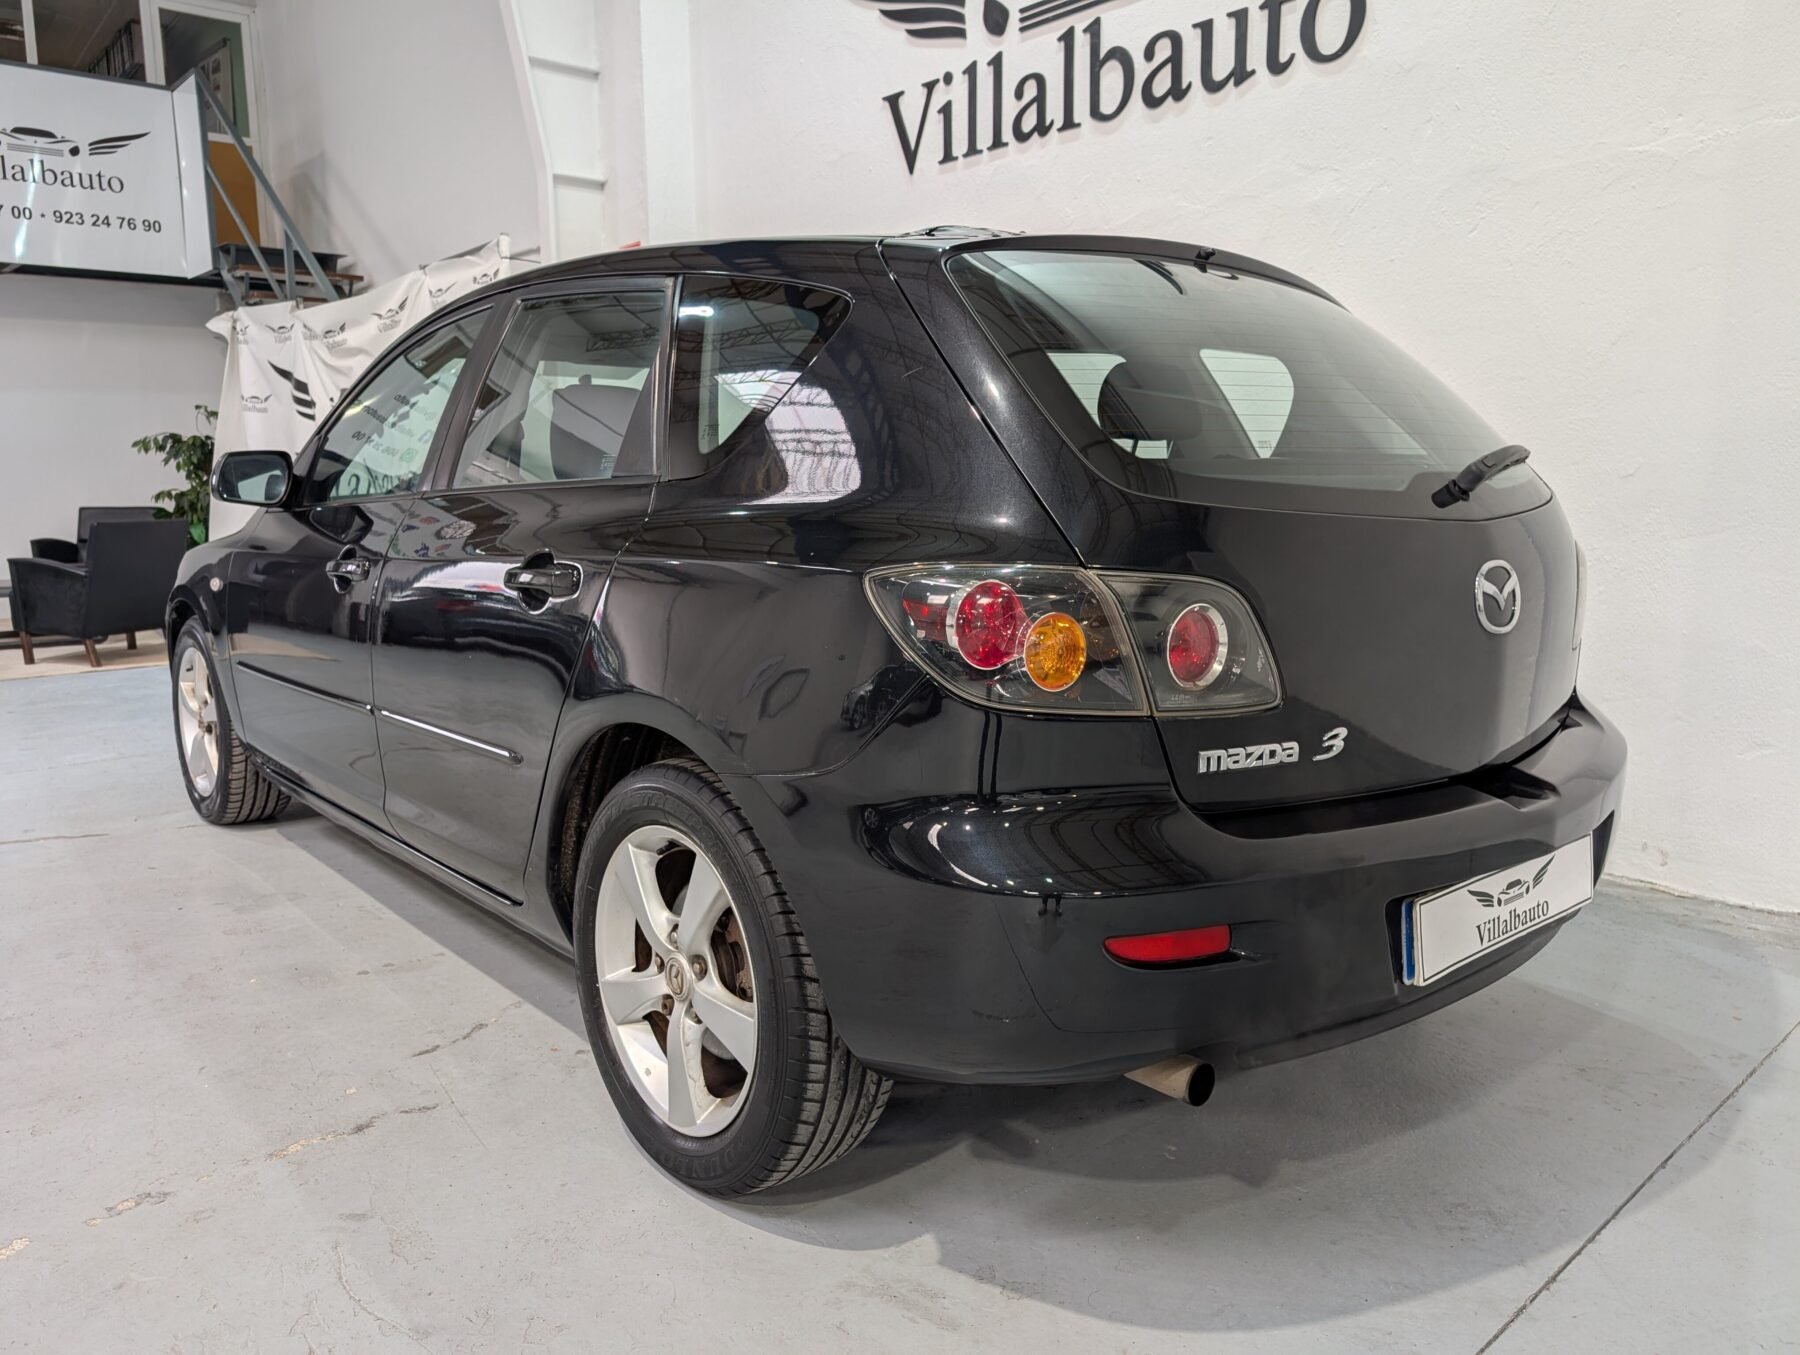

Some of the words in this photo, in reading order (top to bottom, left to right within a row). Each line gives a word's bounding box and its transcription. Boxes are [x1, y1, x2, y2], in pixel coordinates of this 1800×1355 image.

[882, 0, 1367, 175] Villalbauto
[11, 205, 33, 221] 00
[52, 209, 85, 226] 923
[90, 213, 111, 229] 24
[116, 216, 137, 232] 76
[142, 219, 162, 234] 90
[1312, 726, 1349, 762] 3
[1476, 899, 1550, 948] Villalbauto
